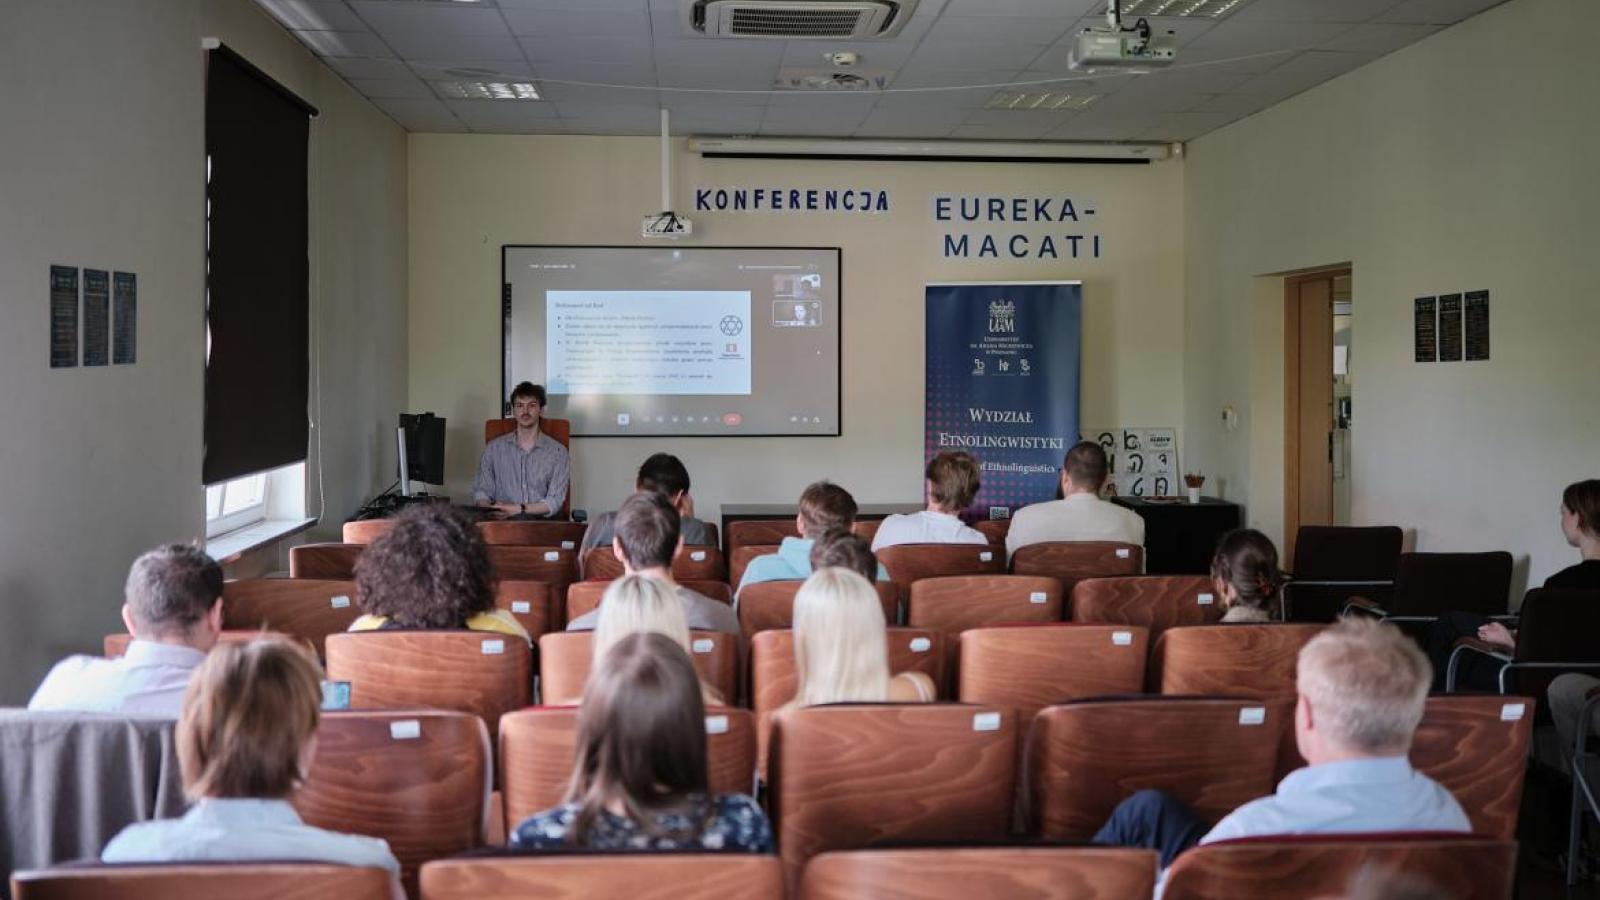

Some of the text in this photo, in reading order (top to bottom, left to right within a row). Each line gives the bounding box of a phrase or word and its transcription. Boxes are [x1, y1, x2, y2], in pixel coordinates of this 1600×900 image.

[696, 189, 889, 211] KONFERENCJA
[935, 198, 1096, 222] EUREKA-
[944, 234, 1100, 258] MACATI
[969, 408, 1034, 423] WYDZIAŁ
[940, 432, 1064, 449] ETNOLINGWISTYKI
[987, 462, 1055, 474] Ethnolinguistics
